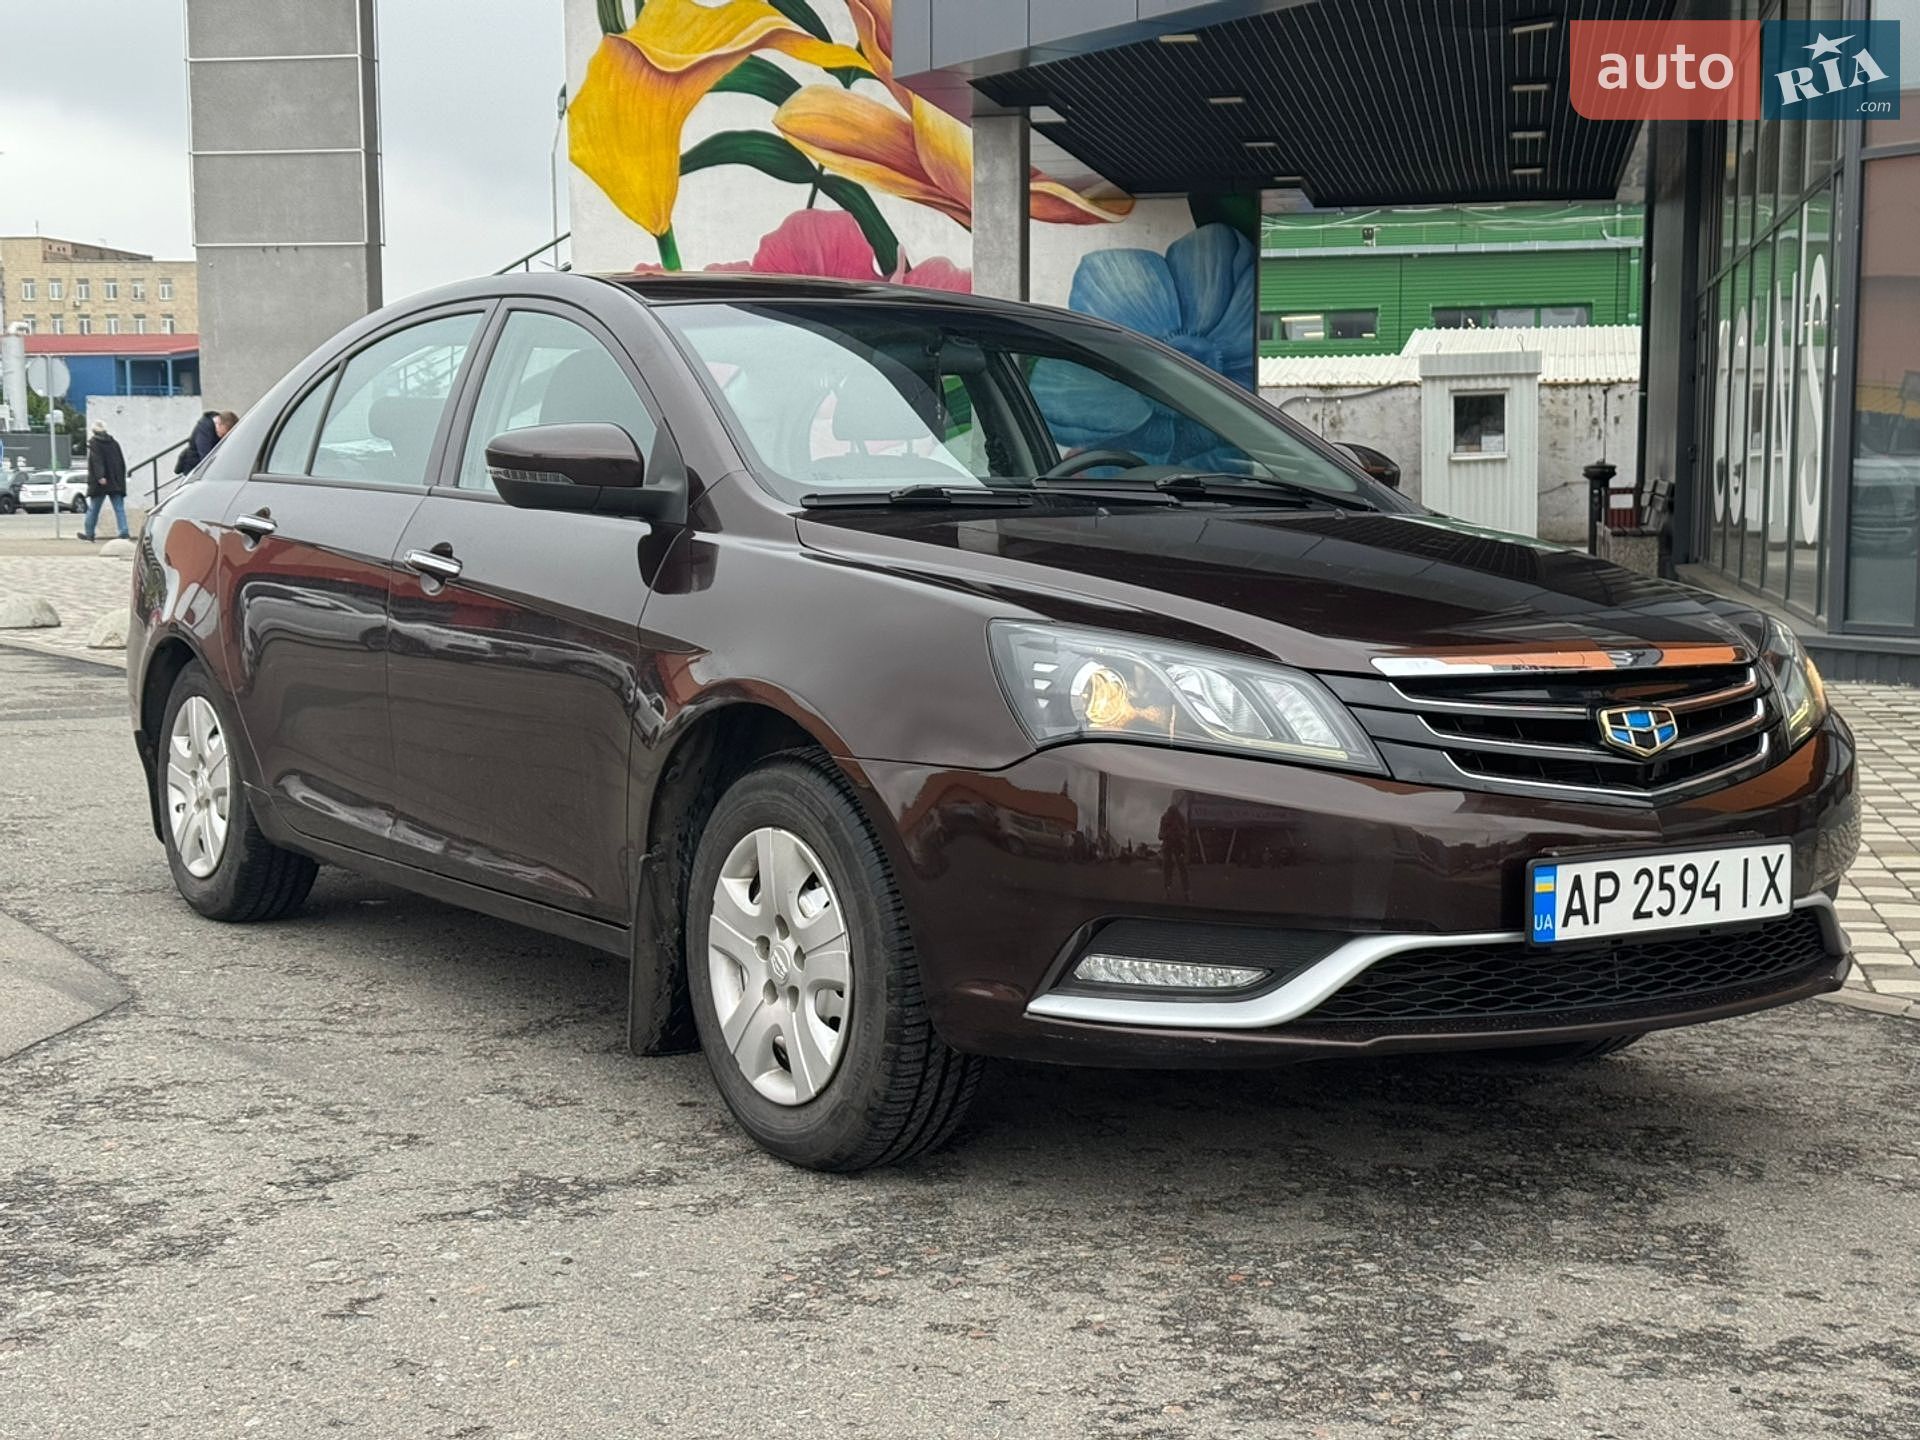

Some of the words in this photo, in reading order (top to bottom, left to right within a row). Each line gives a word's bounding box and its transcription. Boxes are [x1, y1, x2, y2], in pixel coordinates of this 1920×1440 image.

[1561, 870, 1620, 928] AP
[1632, 860, 1721, 920] 2594
[1742, 854, 1785, 909] IX
[1534, 914, 1553, 931] UA
